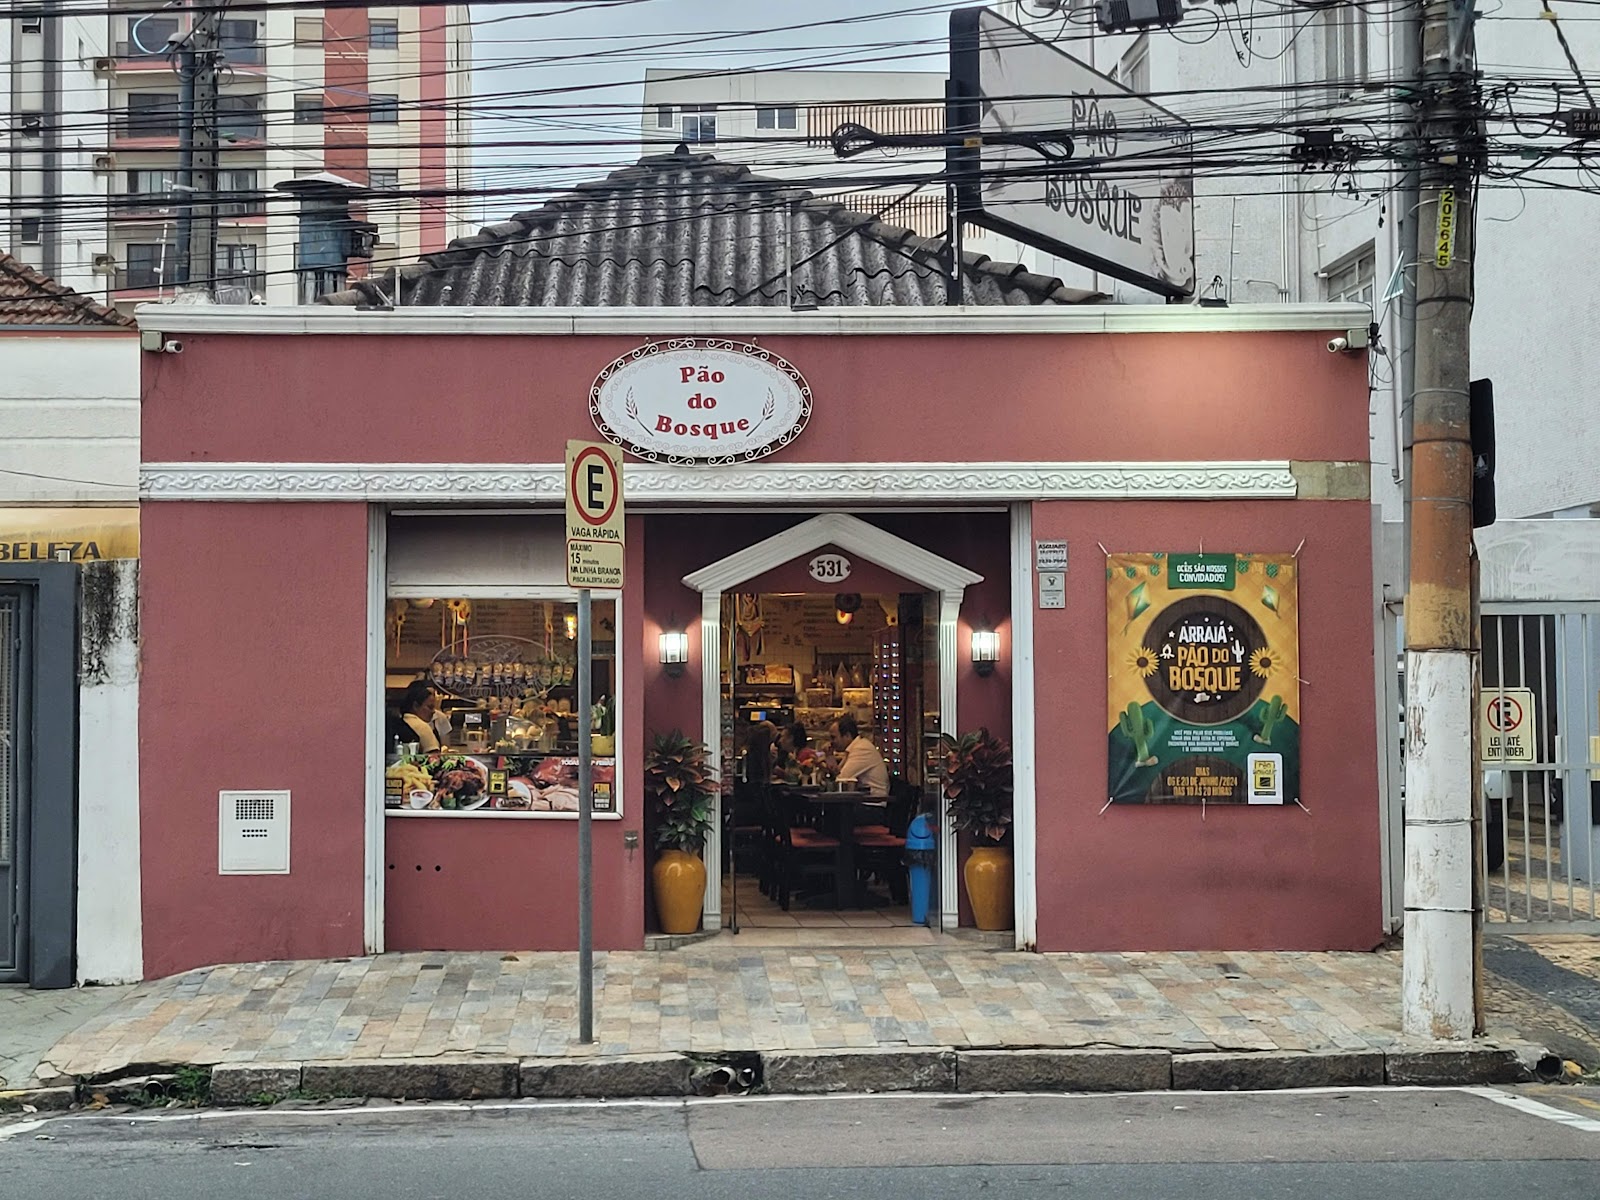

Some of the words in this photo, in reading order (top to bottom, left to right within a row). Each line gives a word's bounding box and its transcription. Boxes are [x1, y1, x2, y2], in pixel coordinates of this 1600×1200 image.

[1438, 190, 1454, 267] 205645
[680, 365, 725, 384] Pão
[687, 393, 717, 409] do
[655, 414, 750, 440] Bosque
[587, 464, 605, 510] E
[571, 526, 591, 538] VAGA
[592, 527, 620, 539] RÁPIDA
[0, 541, 101, 560] BELEZA
[570, 543, 592, 552] MÁXIMO
[570, 552, 581, 564] 15
[597, 567, 621, 576] BRANCA
[817, 560, 843, 577] 531
[1193, 562, 1206, 573] SÃO
[1206, 564, 1228, 573] NOSSOS
[1179, 573, 1226, 583] CONVIDADOS!
[1178, 620, 1228, 644] ARRAIÁ
[1177, 643, 1209, 667] PÃO
[1211, 648, 1230, 664] DO
[1168, 665, 1242, 694] BOSQUE
[1506, 735, 1521, 746] ATÉ
[1487, 747, 1524, 757] ENTNDER
